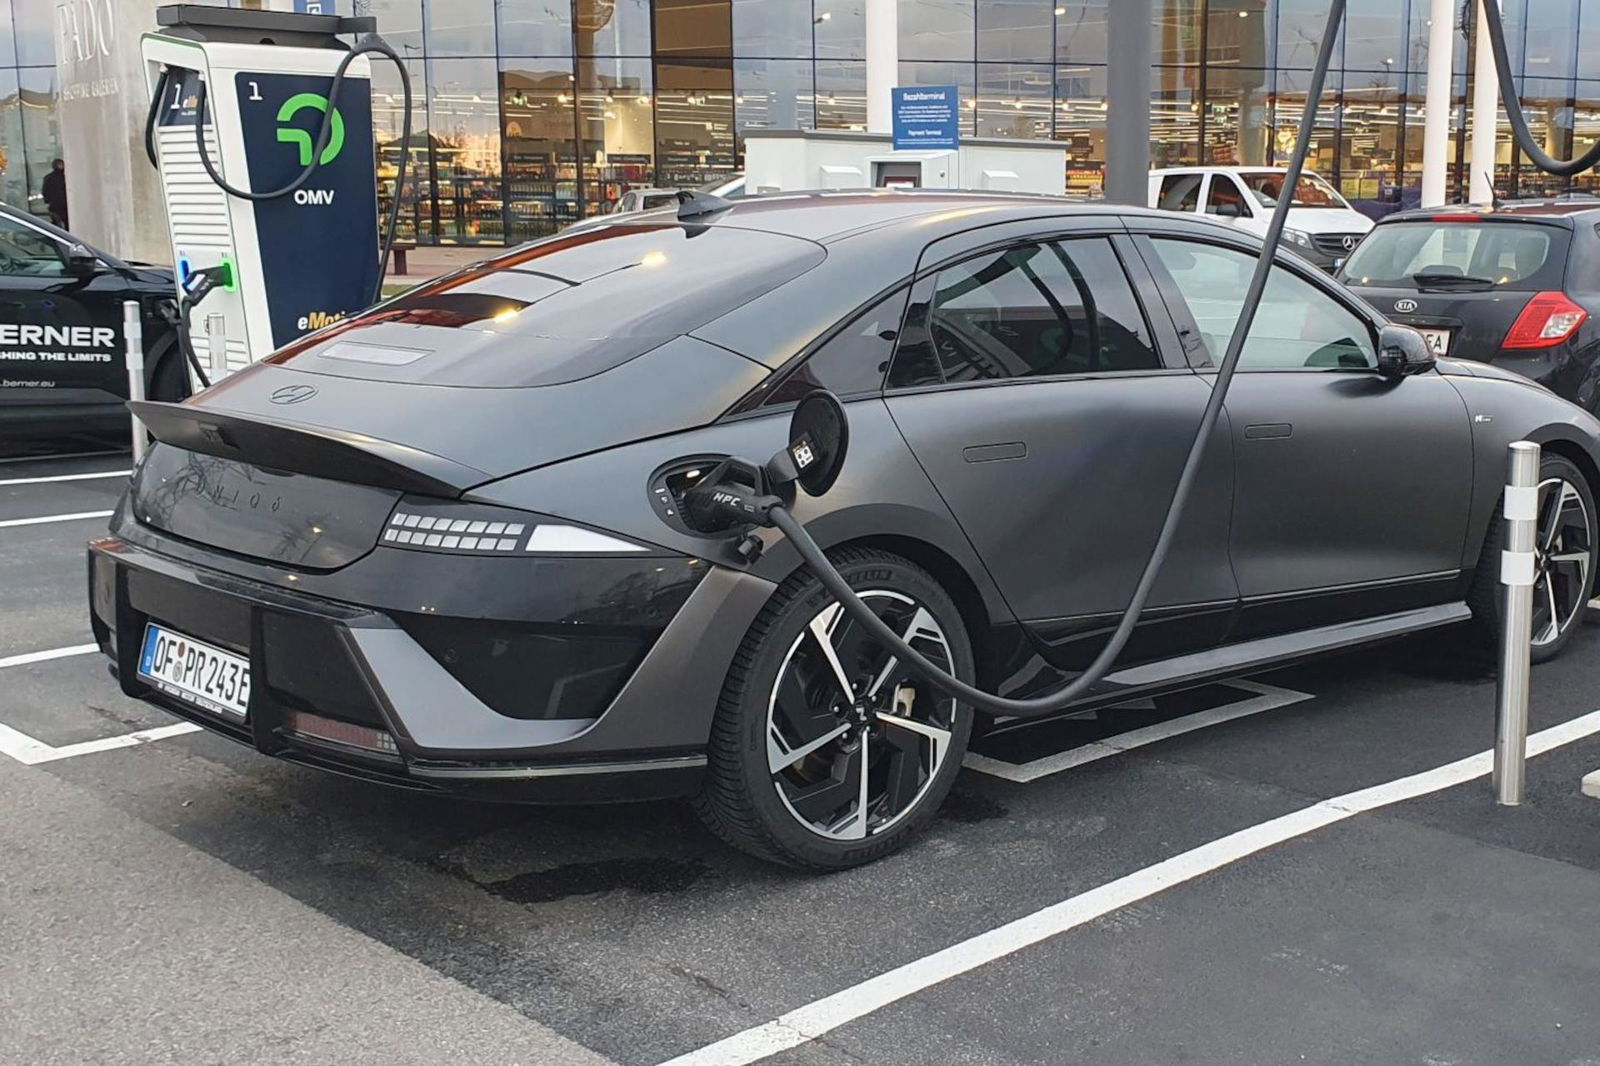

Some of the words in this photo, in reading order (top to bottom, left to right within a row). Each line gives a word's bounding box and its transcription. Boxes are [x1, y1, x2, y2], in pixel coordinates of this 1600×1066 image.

[170, 83, 181, 109] 1
[248, 82, 263, 100] 1
[294, 189, 334, 205] OMV
[0, 324, 115, 347] ERNER
[0, 351, 37, 360] HING
[38, 352, 66, 361] THE
[67, 353, 112, 362] LIMITS
[713, 492, 741, 507] HPC
